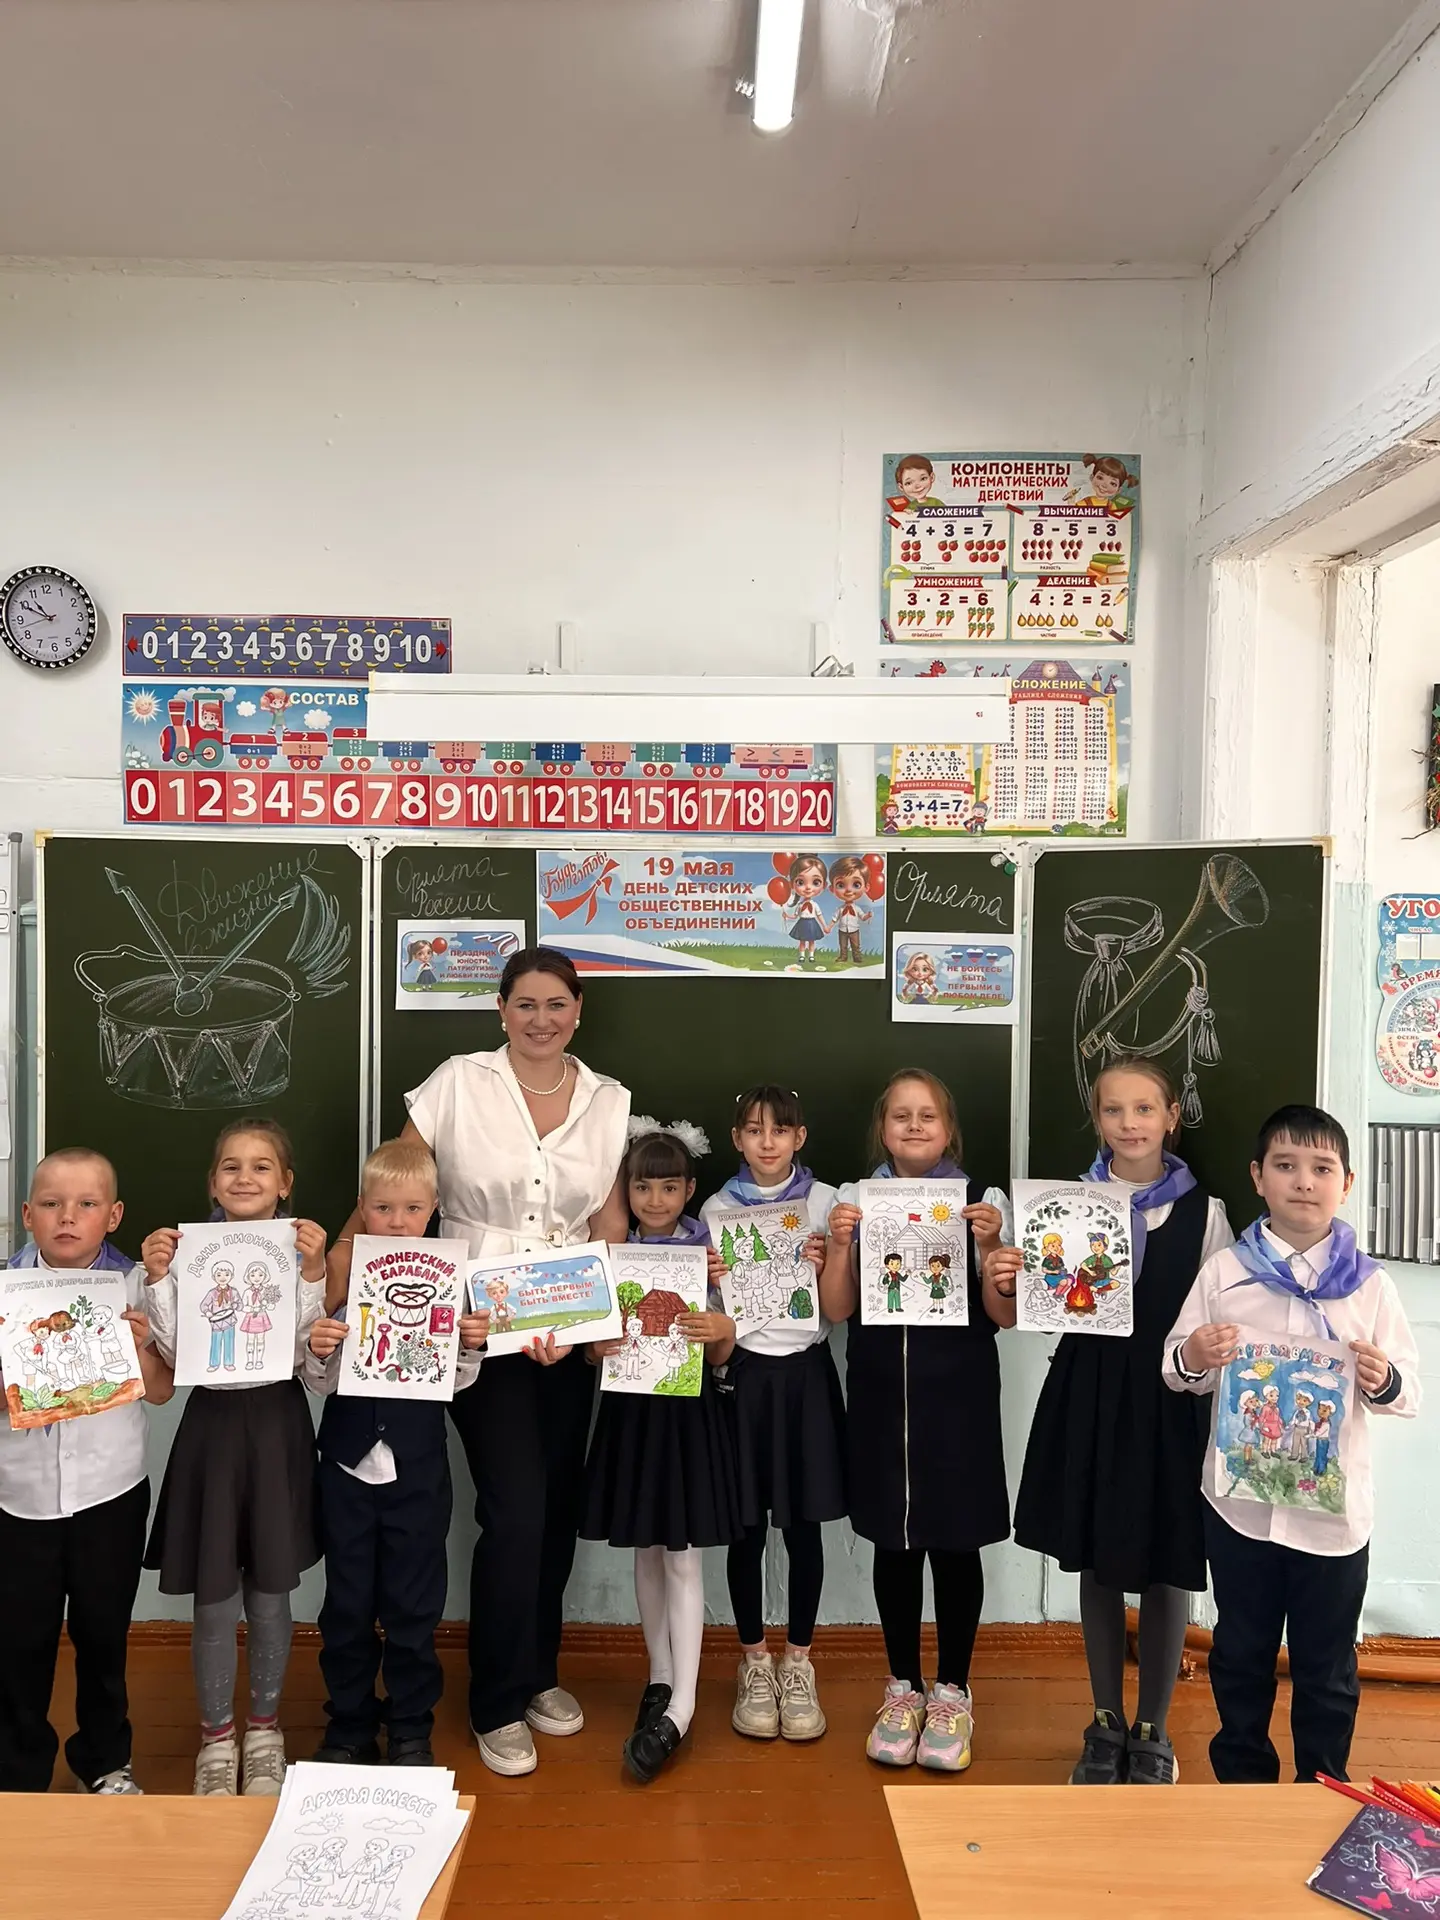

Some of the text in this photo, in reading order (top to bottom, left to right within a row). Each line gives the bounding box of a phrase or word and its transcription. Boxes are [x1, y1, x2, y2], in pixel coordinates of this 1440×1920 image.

[951, 463, 1070, 476] КОМПОНЕНТЫ
[953, 476, 1068, 487] МАТЕМАТИЧЕСКИХ
[978, 489, 1044, 502] ДЕЙСТВИЙ
[923, 508, 979, 516] СЛОЖЕНИЕ
[906, 524, 917, 536] 4
[944, 524, 954, 537] 3
[983, 524, 992, 536] 7
[1033, 523, 1043, 536] 8
[1068, 523, 1078, 536] 5
[1106, 524, 1116, 536] 3
[917, 578, 979, 586] УМНОЖЕНИЕ
[29, 589, 37, 598] 11
[41, 585, 52, 594] 12
[59, 588, 63, 597] 1
[20, 600, 29, 610] 10
[71, 598, 77, 607] 2
[907, 593, 917, 605] 3
[940, 593, 950, 605] 2
[978, 593, 988, 606] 6
[1030, 593, 1040, 606] 4
[1063, 593, 1073, 606] 2
[1101, 593, 1111, 606] 2
[17, 616, 24, 624] 9
[77, 612, 84, 621] 3
[25, 630, 31, 639] 8
[75, 628, 81, 636] 4
[37, 639, 43, 648] 7
[52, 642, 58, 652] 6
[65, 638, 72, 646] 5
[142, 631, 432, 663] 0 1 2 3 4 5 6 7 8 9 10
[1012, 680, 1086, 689] СЛОЖЕНИЕ
[290, 692, 359, 706] СОСТАВ
[251, 735, 256, 743] 1
[129, 778, 832, 827] 0 1 2 3 4 5 6 7 8 9 10 11 12 13 14 15 16 17 18 19 20
[643, 857, 734, 876] 19 мая
[540, 862, 576, 898] Будь
[623, 882, 753, 896] ДЕНЬ ДЕТСКИХ
[619, 899, 763, 914] ОБЩЕСТВЕННЫХ
[625, 915, 756, 932] ОБЪЕДИНЕНИЙ
[962, 965, 1002, 973] БОЙТЕСЬ
[1024, 1187, 1085, 1213] ПИОНЕРСКИЙ
[187, 1232, 290, 1278] День пионерии
[365, 1251, 457, 1278] ПИОНЕРСКИЙ
[380, 1265, 440, 1284] БАРАБАН
[518, 1280, 595, 1298] БЫТЬ ПЕРВЫМ!
[519, 1291, 594, 1307] БЫТЬ ВМЕСТЕ!
[1235, 1343, 1346, 1373] ДРУЗЬЯ ВМЕСТЕ
[300, 1787, 438, 1818] ДРУЗЬЯ ВМЕСТЕ
